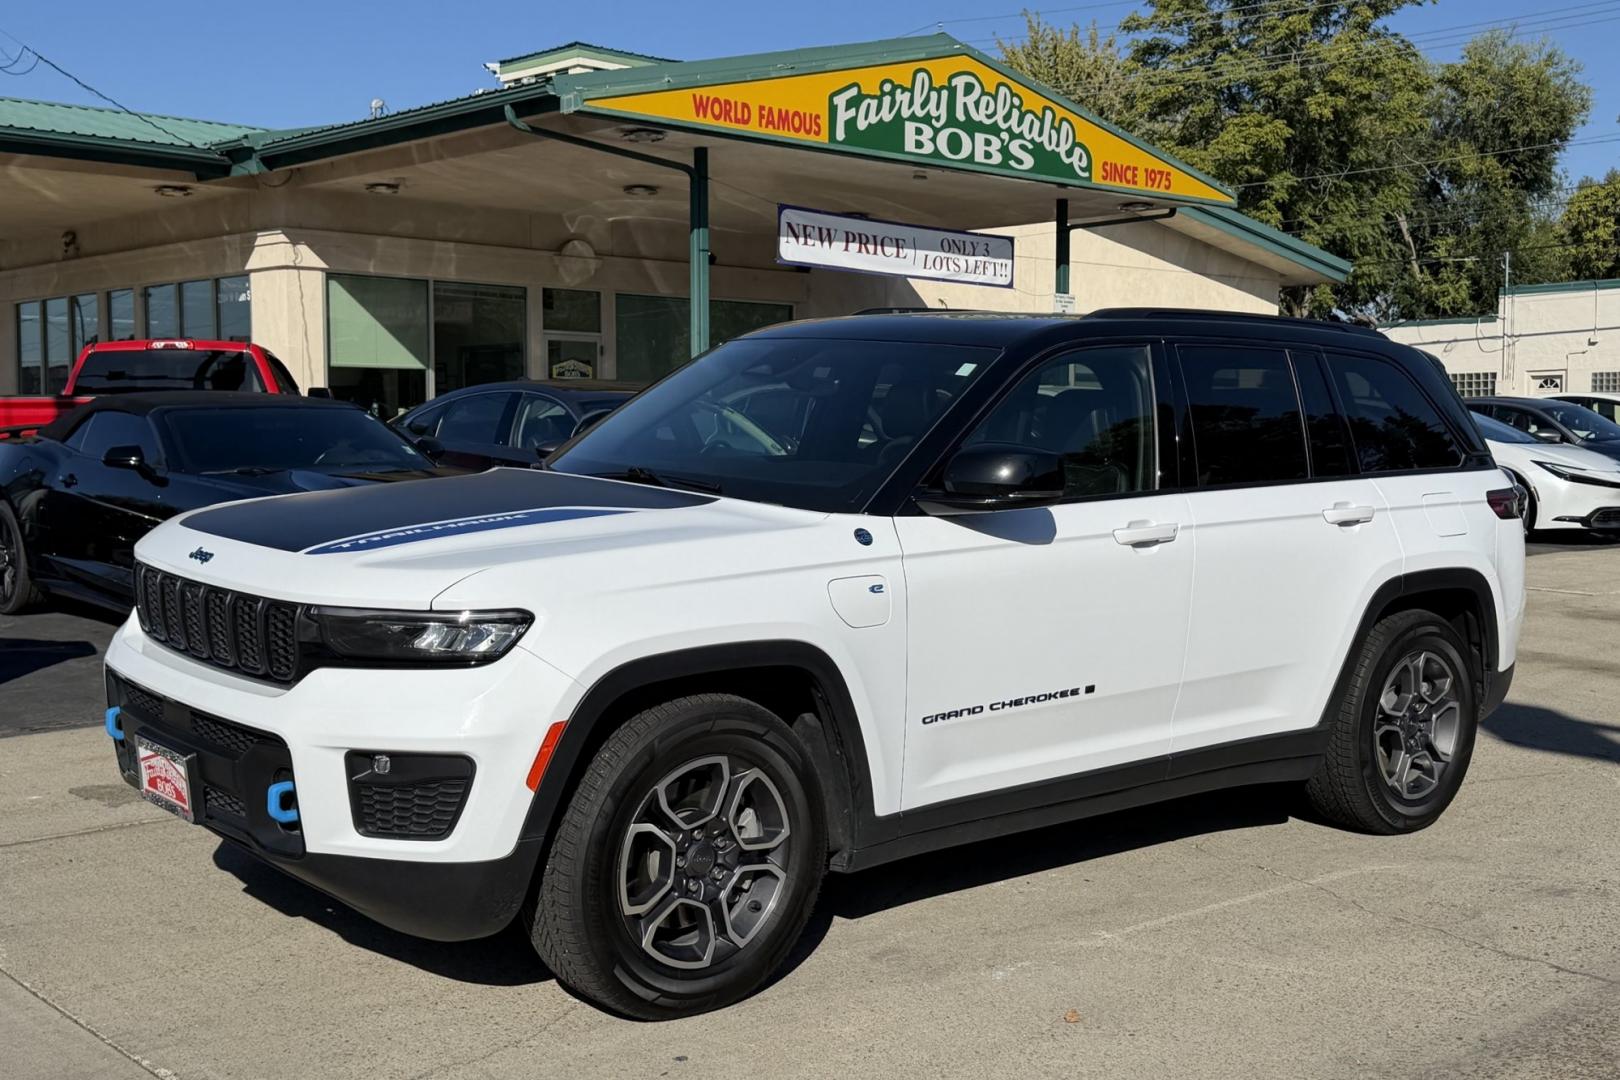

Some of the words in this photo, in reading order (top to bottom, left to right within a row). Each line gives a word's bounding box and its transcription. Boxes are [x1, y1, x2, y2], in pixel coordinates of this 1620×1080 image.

[692, 93, 752, 125] WORLD
[758, 104, 822, 137] FAMOUS
[833, 71, 949, 142] Fairly
[951, 74, 1090, 178] Reliable
[904, 120, 1034, 171] BOB'S
[1101, 160, 1138, 186] SINCE
[1144, 167, 1172, 190] 1975
[785, 221, 838, 251] NEW
[843, 231, 907, 260] PRICE
[940, 236, 978, 258] ONLY
[981, 242, 991, 258] 3
[923, 253, 961, 274] LOTS
[964, 257, 1008, 279] LEFT!!
[329, 512, 530, 550] TRAILHAWK
[188, 546, 215, 565] Jeep
[921, 705, 984, 725] GRAND
[989, 687, 1081, 712] CHEROKEE
